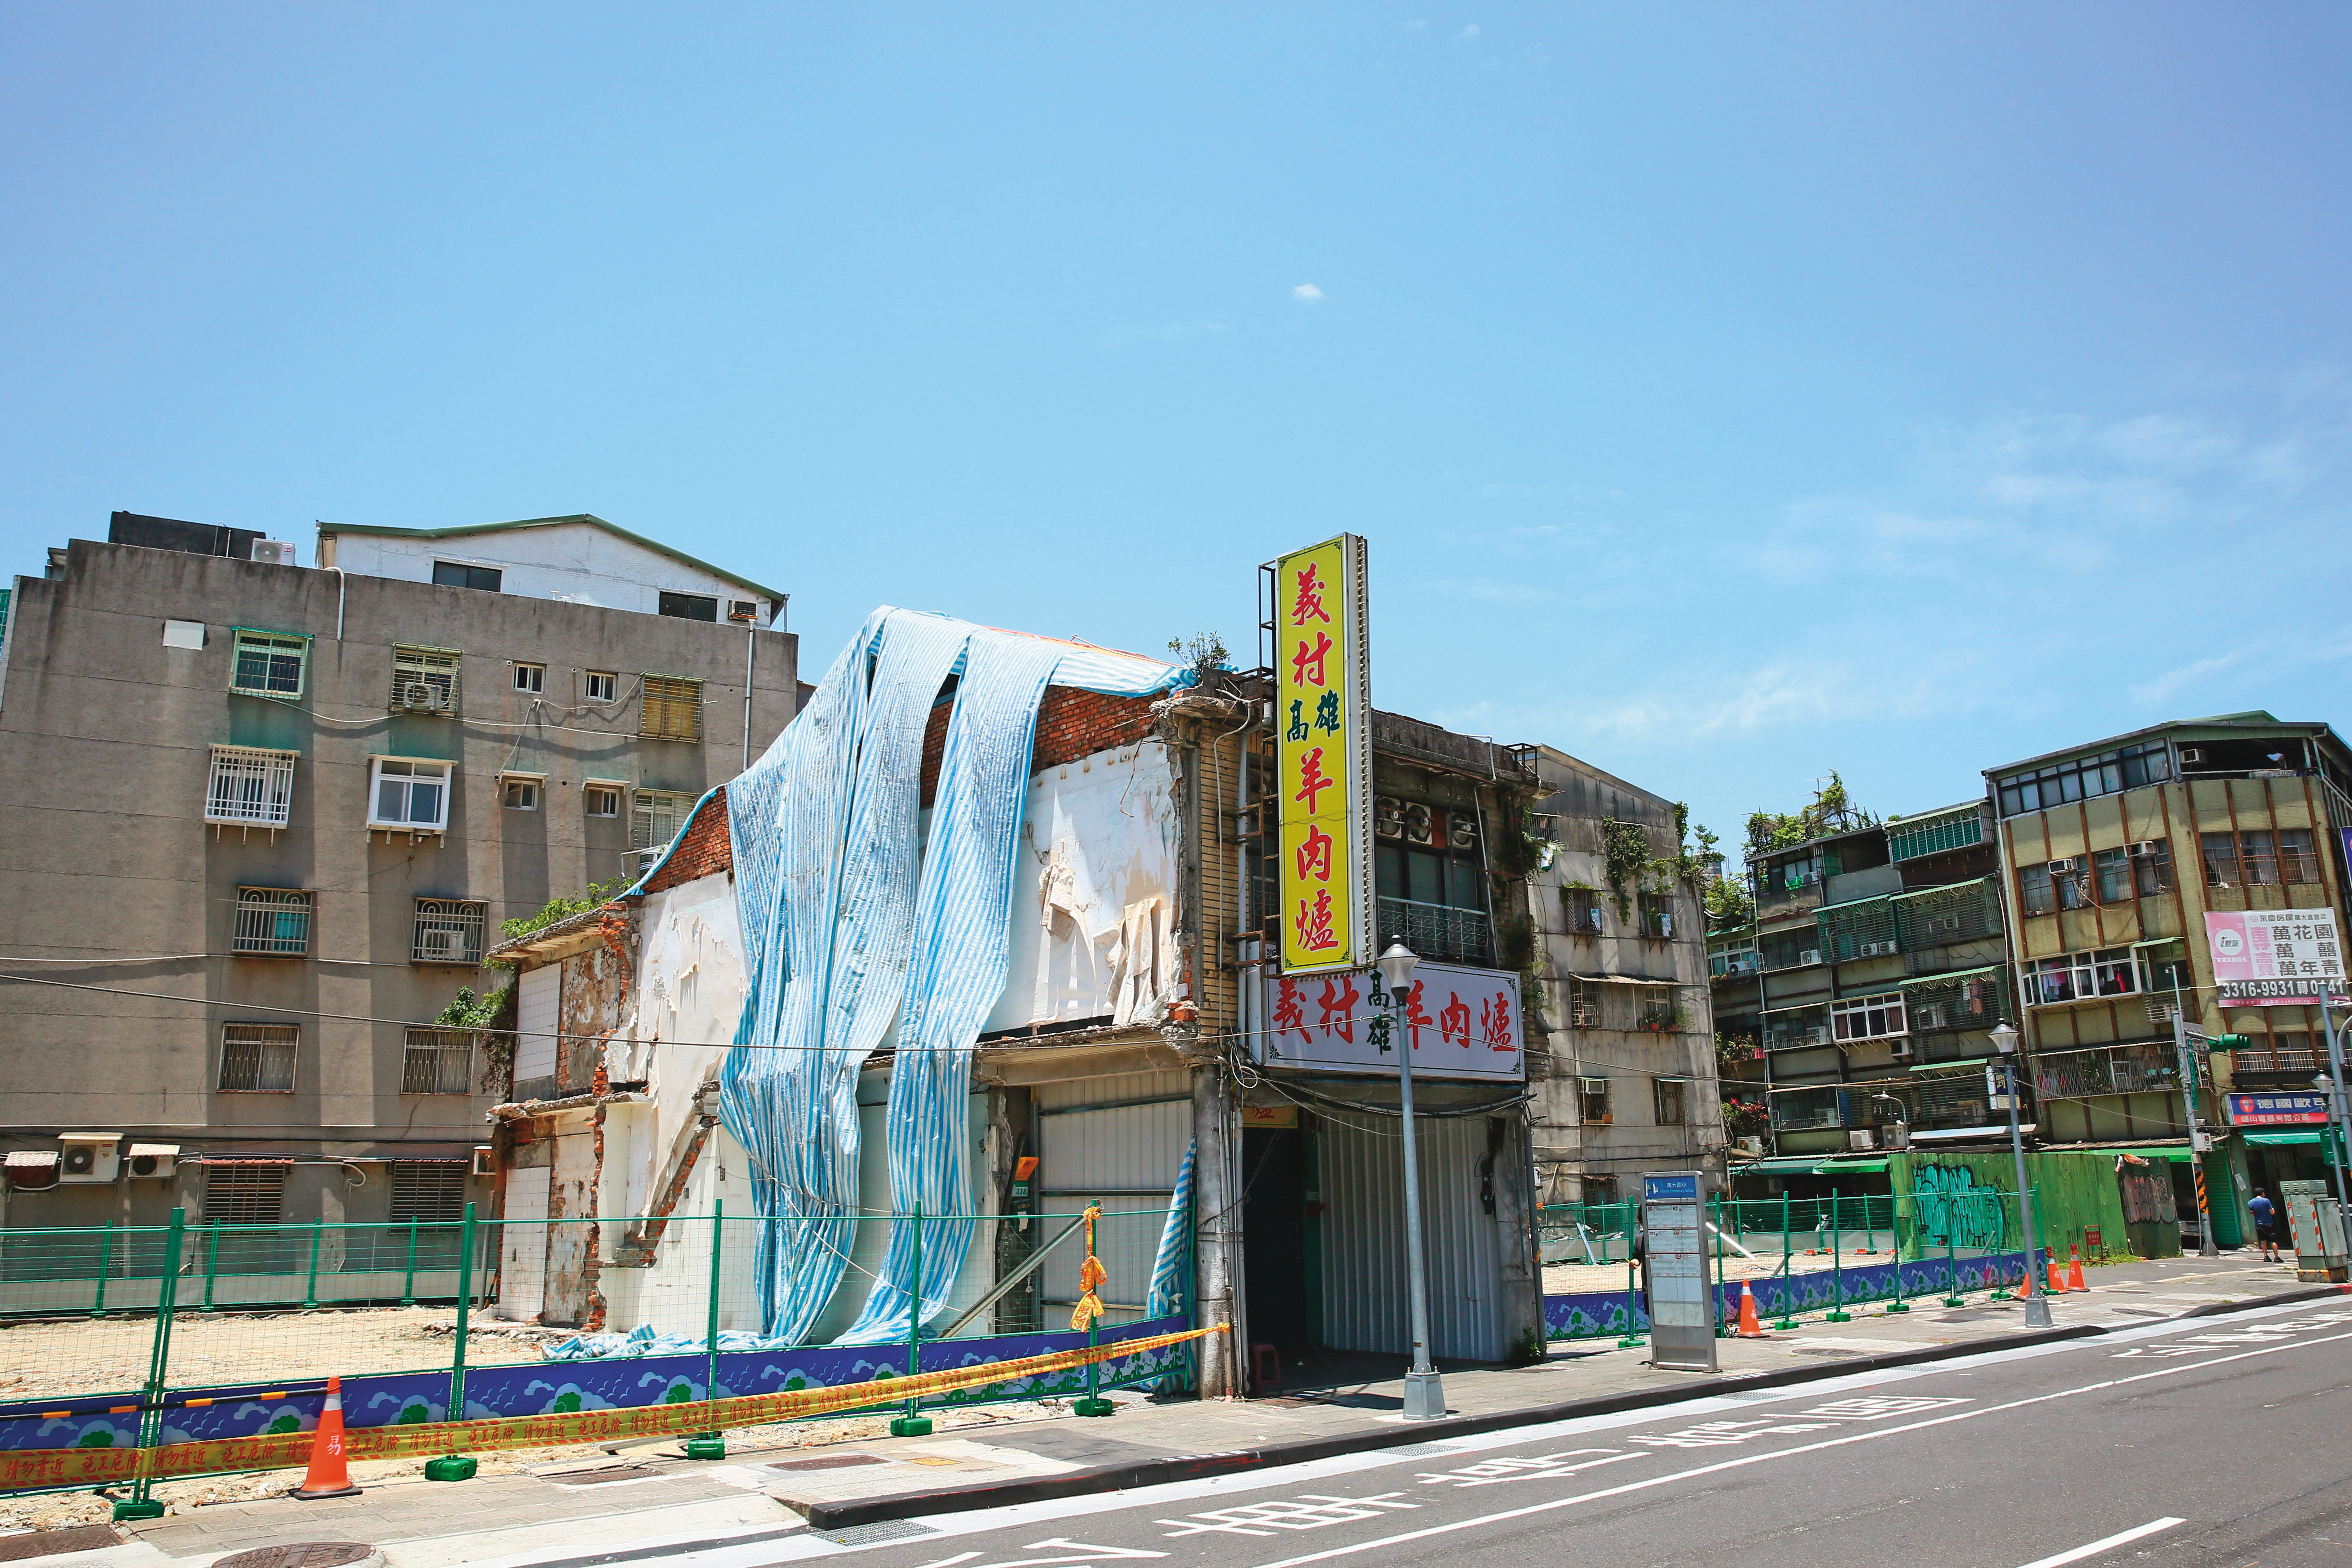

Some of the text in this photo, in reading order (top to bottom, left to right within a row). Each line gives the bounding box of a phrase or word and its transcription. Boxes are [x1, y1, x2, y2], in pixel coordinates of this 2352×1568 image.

[2259, 913, 2294, 922] 永慶房屋
[2271, 923, 2334, 941] 萬花園
[2250, 926, 2275, 977] 專賣
[2278, 959, 2339, 976] 萬年青
[2310, 979, 2344, 996] 041
[350, 1435, 401, 1454] 施工危險
[408, 1430, 454, 1450] 請勿靠近
[468, 1426, 515, 1445] 施工危險
[523, 1421, 566, 1441] 請勿靠近
[578, 1417, 623, 1436] 施工危險
[630, 1412, 670, 1432] 請勿靠近
[682, 1408, 722, 1426] 施工危險
[152, 1446, 206, 1469] 請勿靠近
[221, 1443, 277, 1463] 施工危險
[286, 1441, 314, 1460] 請勿
